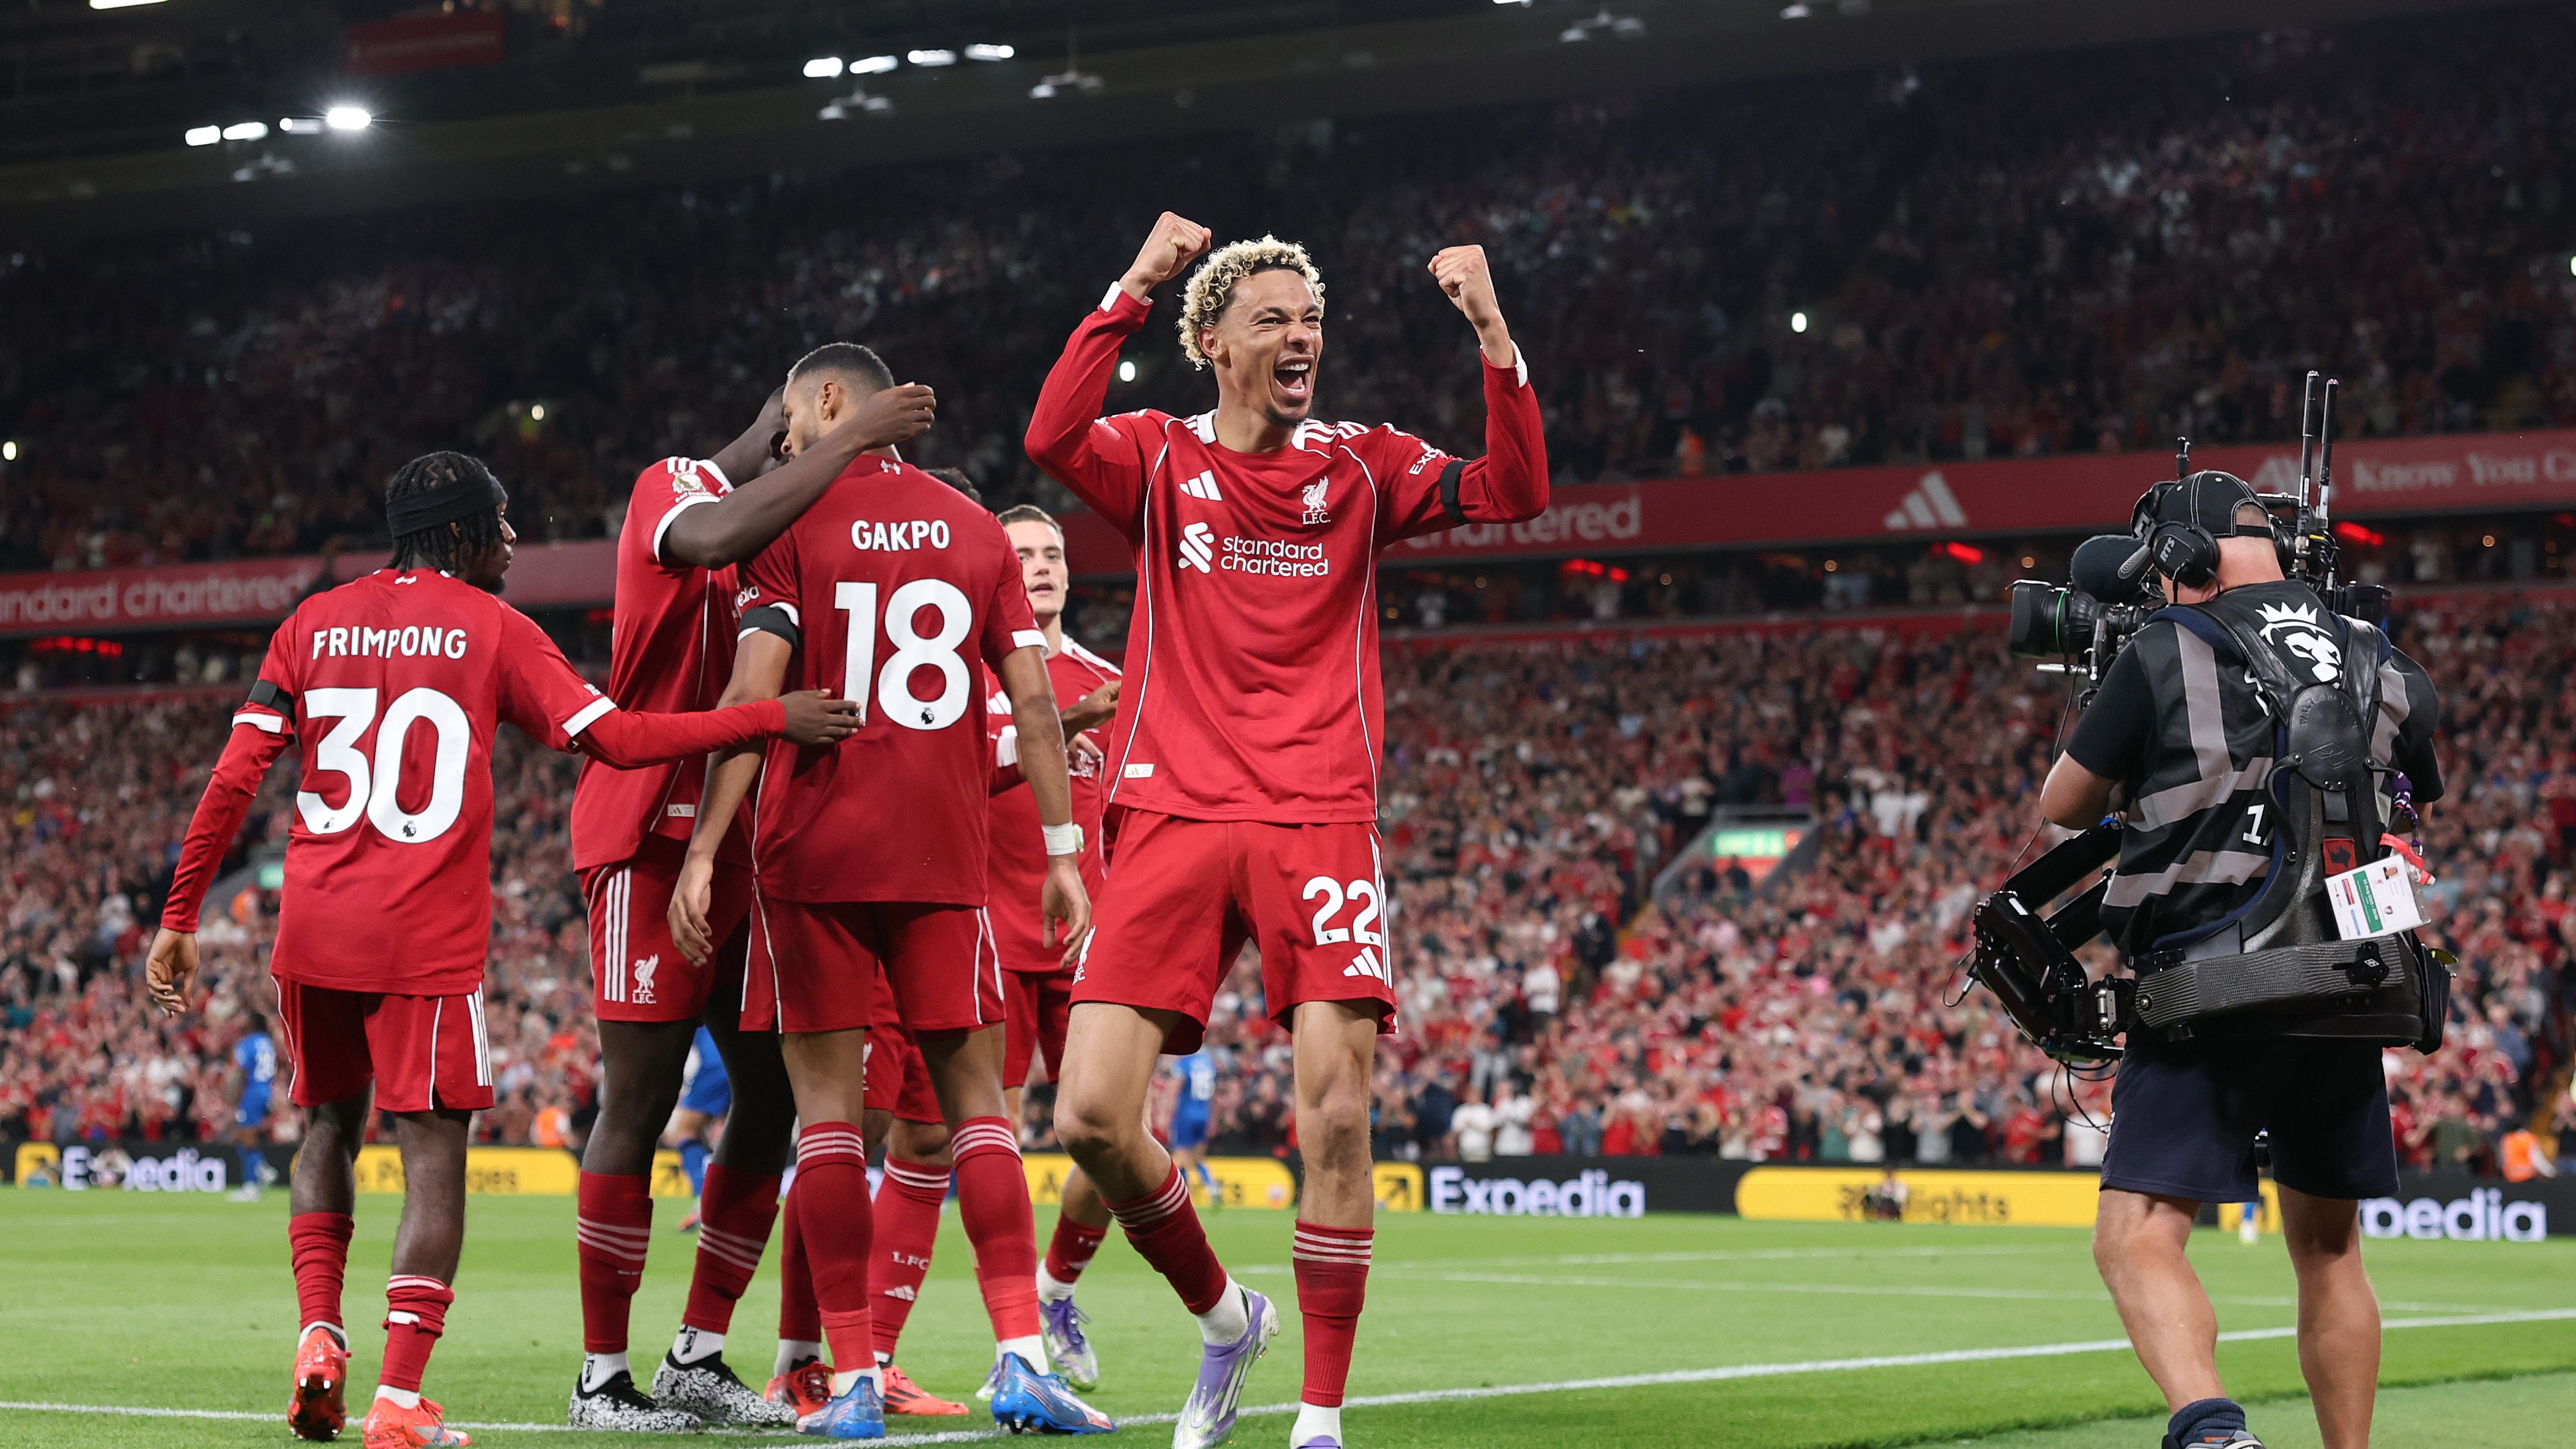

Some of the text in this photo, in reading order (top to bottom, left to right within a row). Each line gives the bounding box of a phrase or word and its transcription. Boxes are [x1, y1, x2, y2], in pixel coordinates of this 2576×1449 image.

[852, 520, 949, 551] GAKPO
[1302, 511, 1331, 525] L.F.C.
[1220, 553, 1329, 577] chartered
[1222, 535, 1323, 559] standard
[2159, 536, 2175, 562] RTS
[313, 625, 467, 660] FRIMPONG
[834, 578, 973, 730] 18
[296, 686, 471, 844] 30
[2242, 804, 2274, 847] 1
[1302, 875, 1383, 949] 22
[1429, 1165, 1646, 1218] Expedia
[2360, 1187, 2547, 1242] pedia
